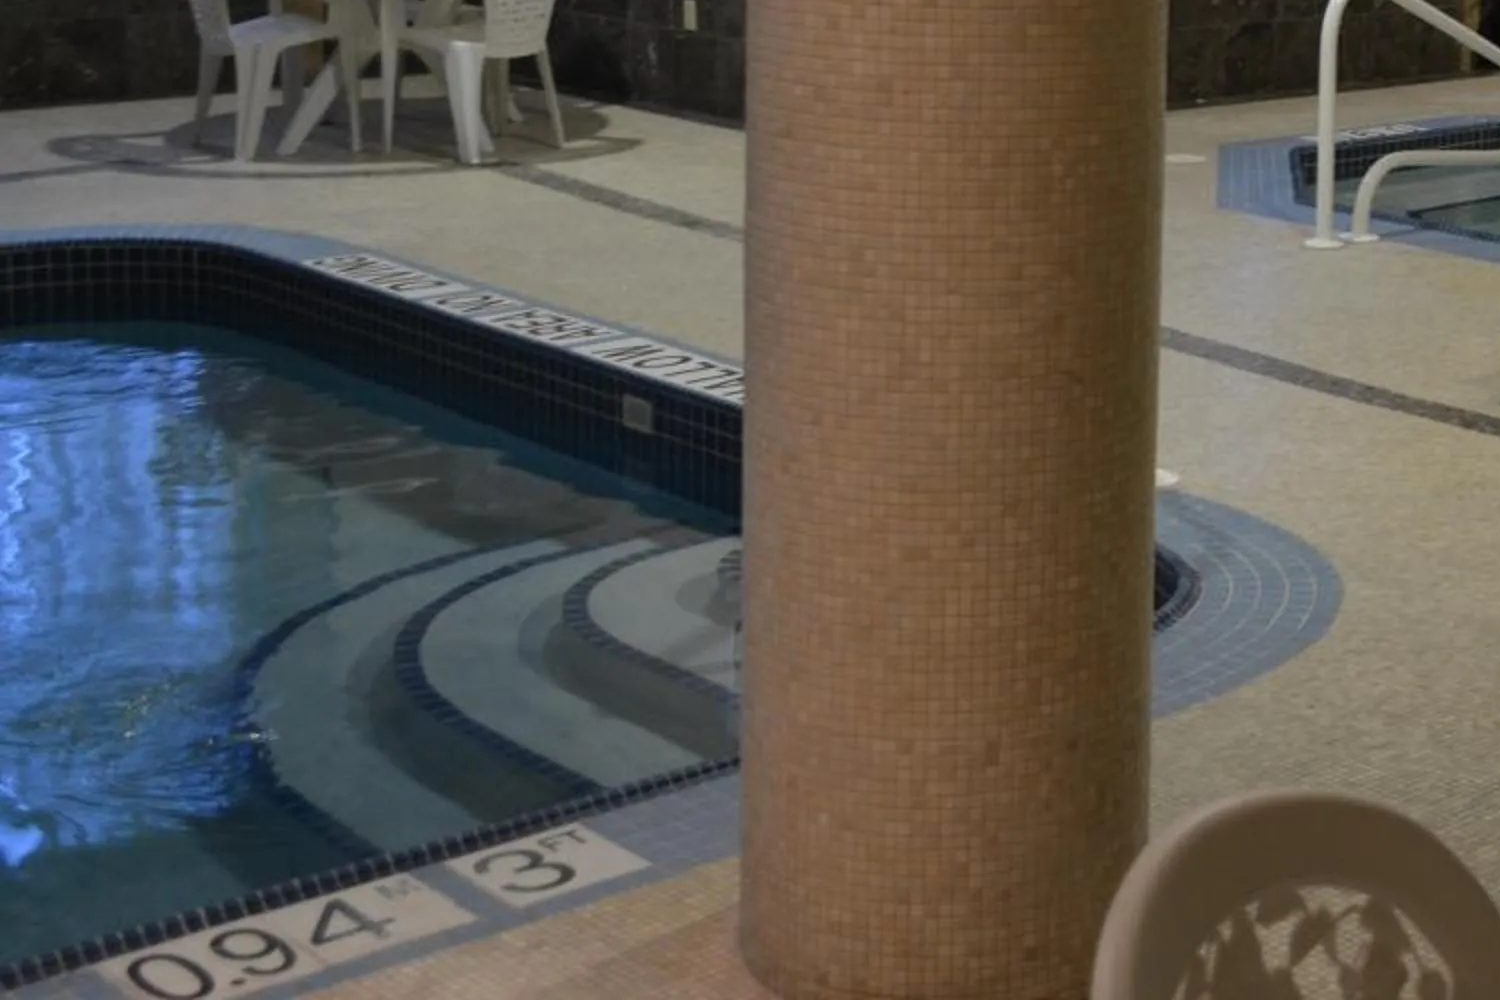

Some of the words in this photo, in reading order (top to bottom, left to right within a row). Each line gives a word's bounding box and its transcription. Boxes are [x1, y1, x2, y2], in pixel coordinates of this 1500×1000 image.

[436, 294, 512, 315] NO
[489, 308, 612, 341] AREA
[591, 343, 745, 401] ALLOW
